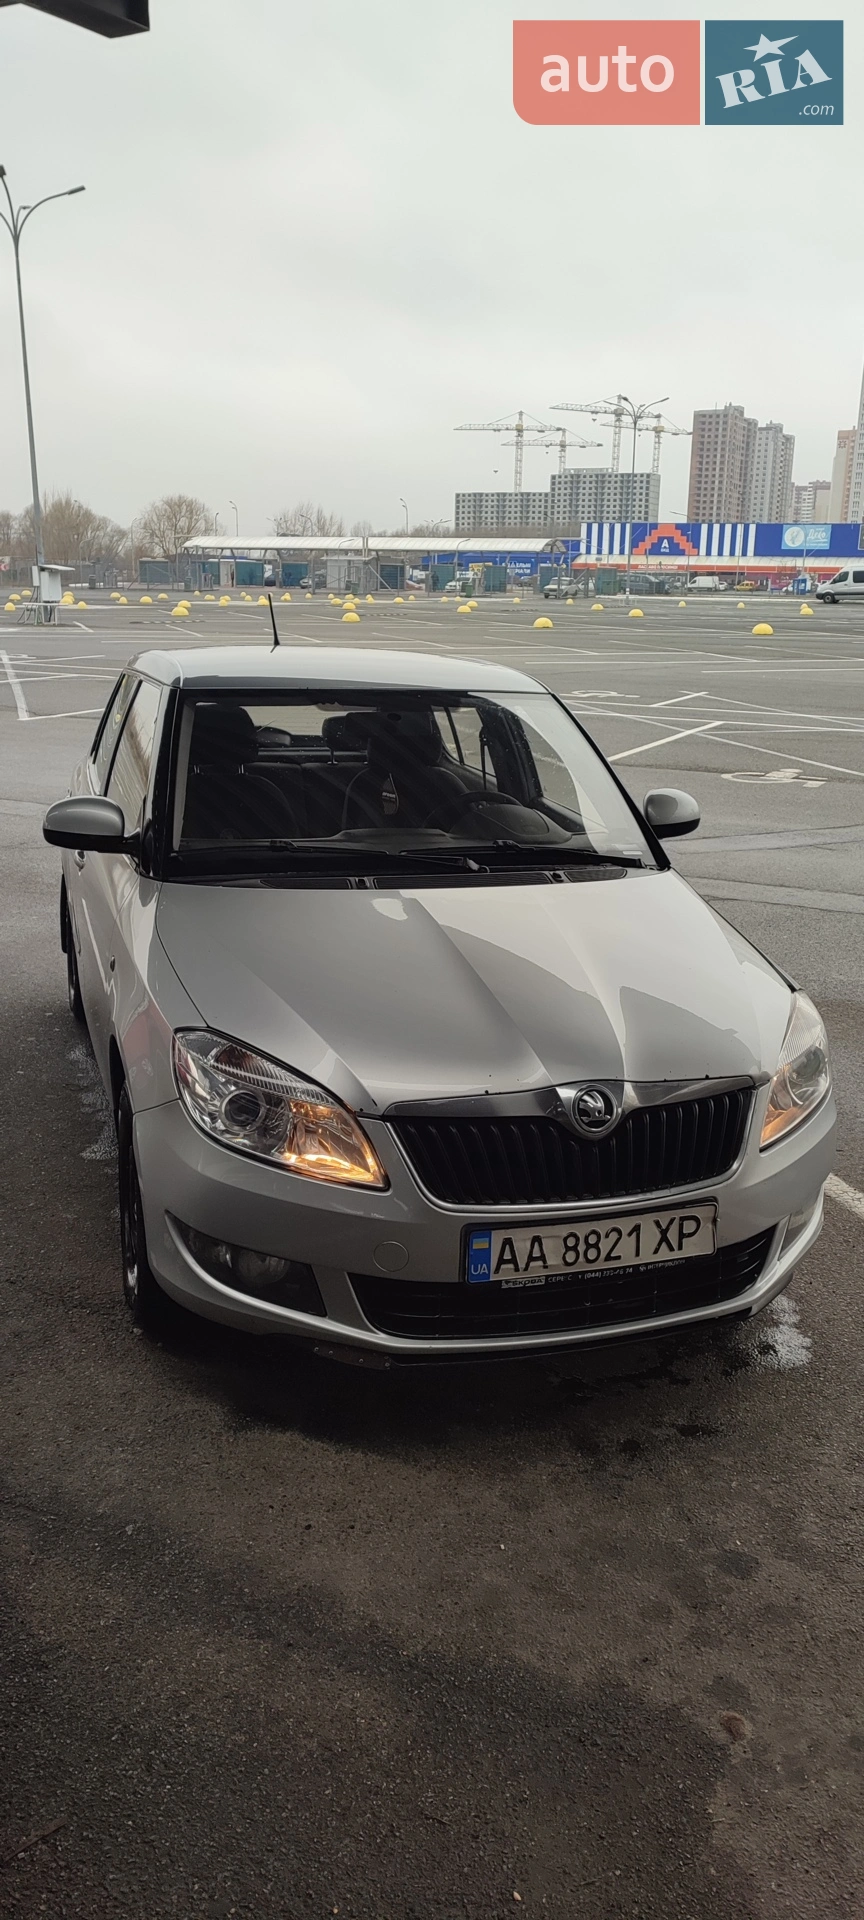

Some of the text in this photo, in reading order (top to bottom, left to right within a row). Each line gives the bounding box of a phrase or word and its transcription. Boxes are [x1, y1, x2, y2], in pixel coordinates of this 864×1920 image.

[493, 1215, 702, 1275] AA 8821 XP
[471, 1264, 488, 1275] UA
